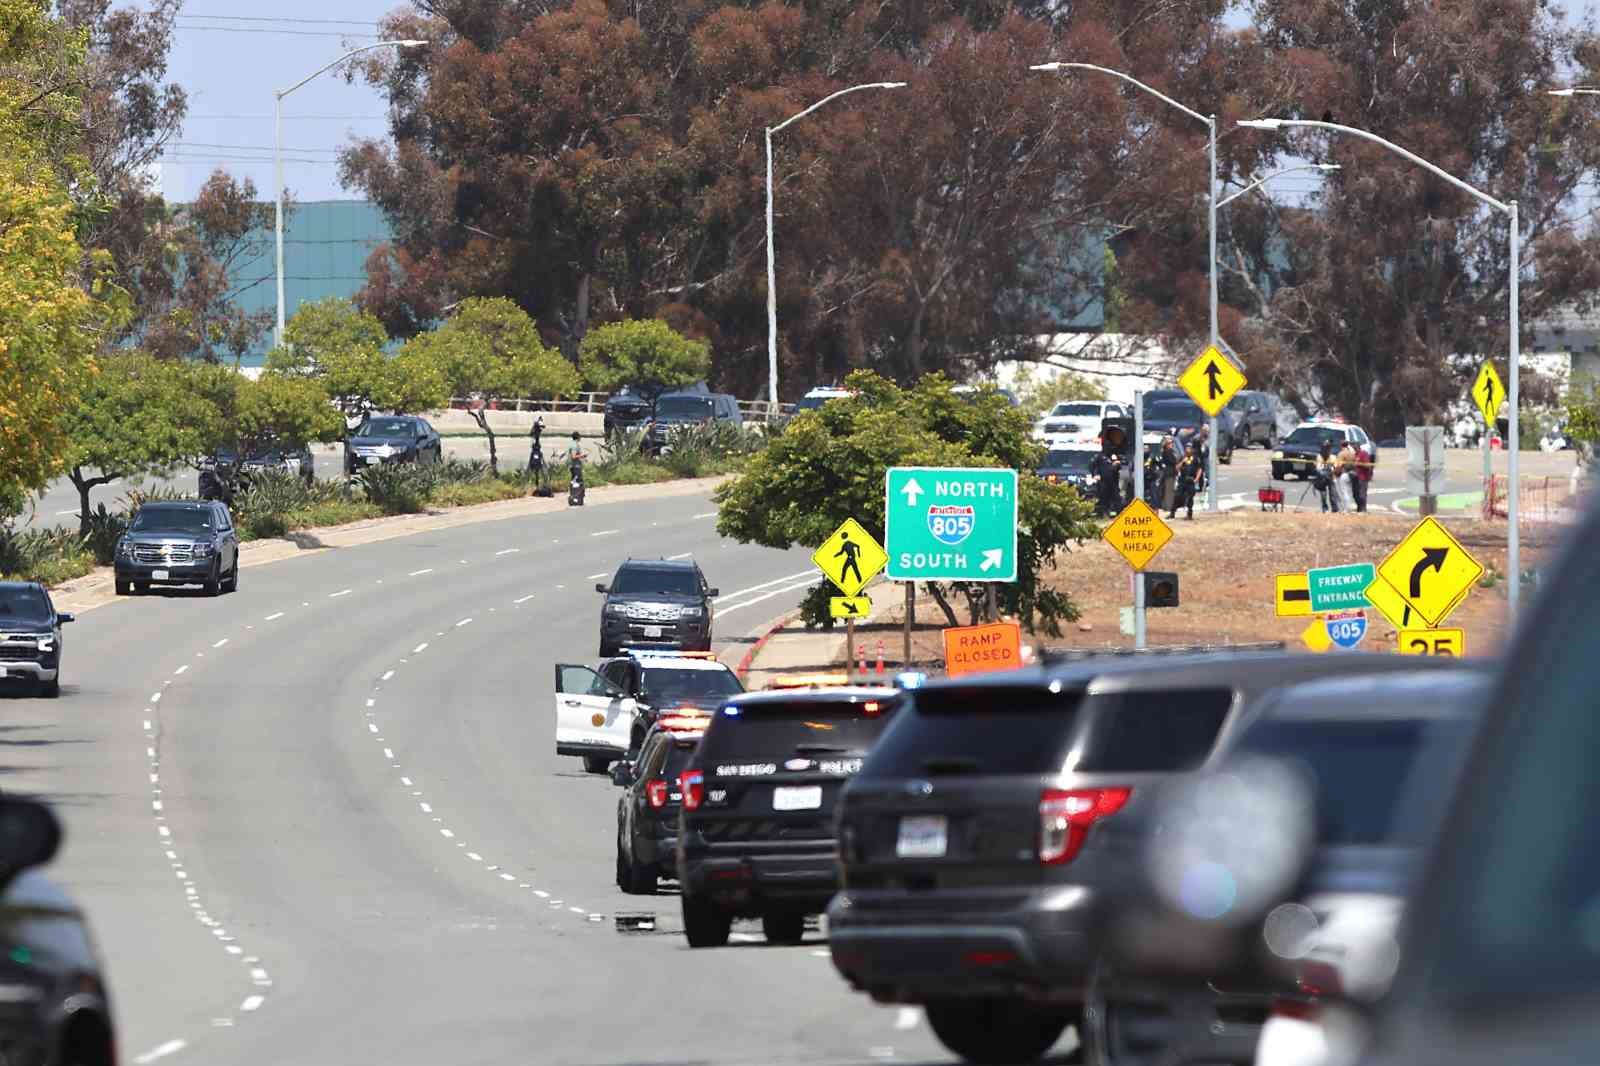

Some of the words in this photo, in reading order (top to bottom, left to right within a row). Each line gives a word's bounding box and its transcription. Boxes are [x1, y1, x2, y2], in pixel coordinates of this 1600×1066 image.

[935, 481, 1004, 497] NORTH
[932, 517, 970, 536] 805
[1124, 516, 1152, 526] RAMP
[1123, 529, 1153, 538] METER
[1123, 543, 1154, 552] AHEAD
[899, 553, 968, 568] SOUTH
[1319, 574, 1363, 587] FREEWAY
[1319, 592, 1363, 604] ENTRANC
[1332, 623, 1361, 640] 805
[960, 632, 1002, 647] RAMP
[955, 648, 1012, 663] CLOSED
